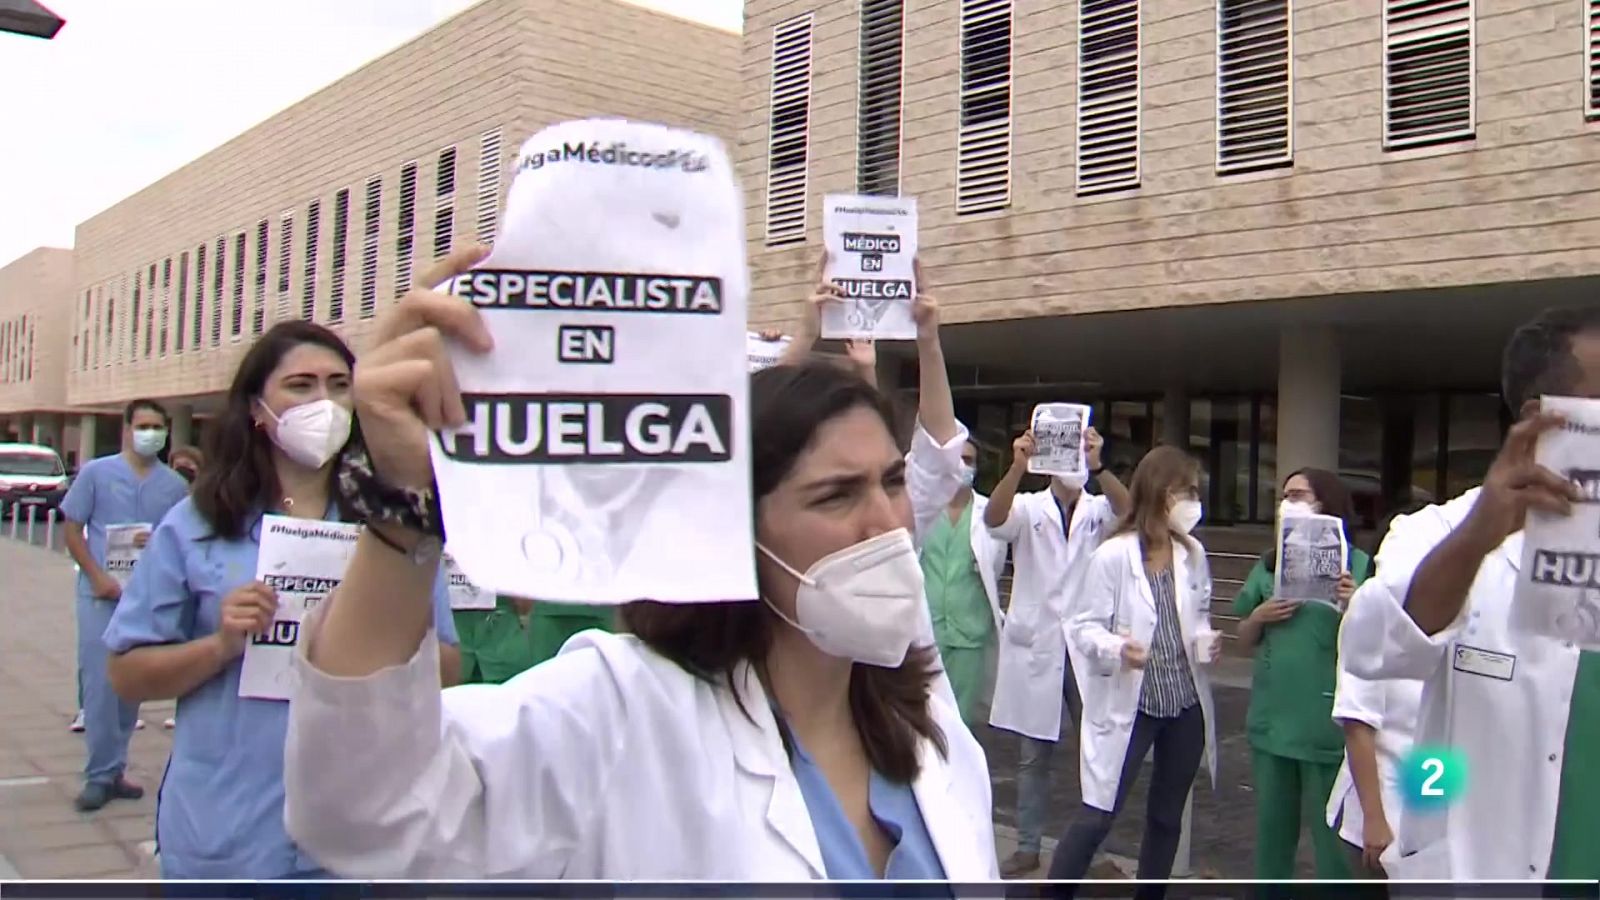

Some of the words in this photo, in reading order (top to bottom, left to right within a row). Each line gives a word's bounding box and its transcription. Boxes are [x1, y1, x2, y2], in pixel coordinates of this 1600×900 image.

[845, 234, 899, 251] MÉDICO
[862, 259, 881, 270] EN
[453, 275, 719, 311] ESPECIALISTA
[561, 329, 612, 360] EN
[445, 402, 726, 456] HUELGA
